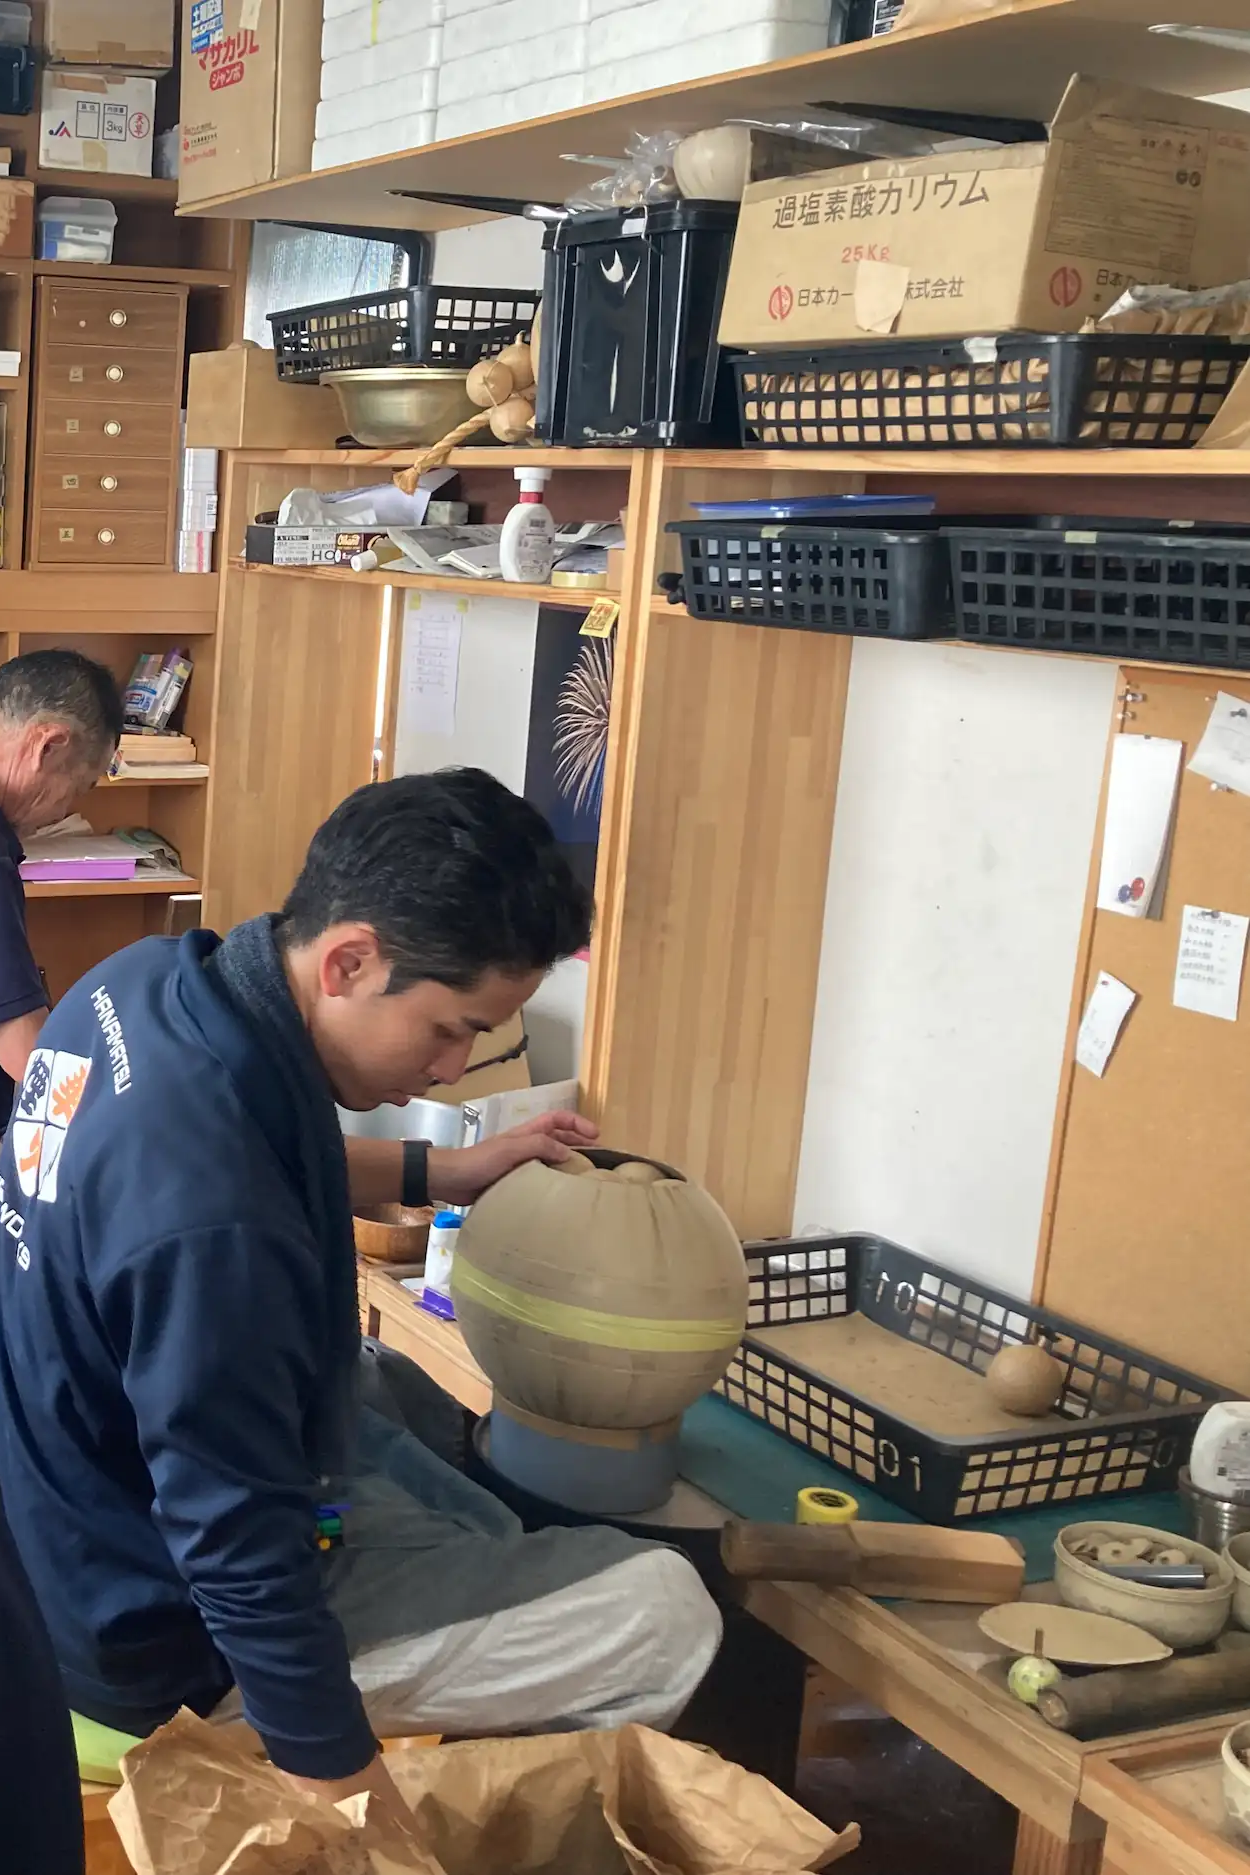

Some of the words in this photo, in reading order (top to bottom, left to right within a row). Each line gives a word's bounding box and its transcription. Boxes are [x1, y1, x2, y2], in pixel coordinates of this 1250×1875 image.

[212, 63, 243, 89] ジャンボ
[106, 120, 123, 134] 3kg
[772, 170, 990, 229] 過塩素酸カリウム
[90, 984, 132, 1095] HANAMATSU
